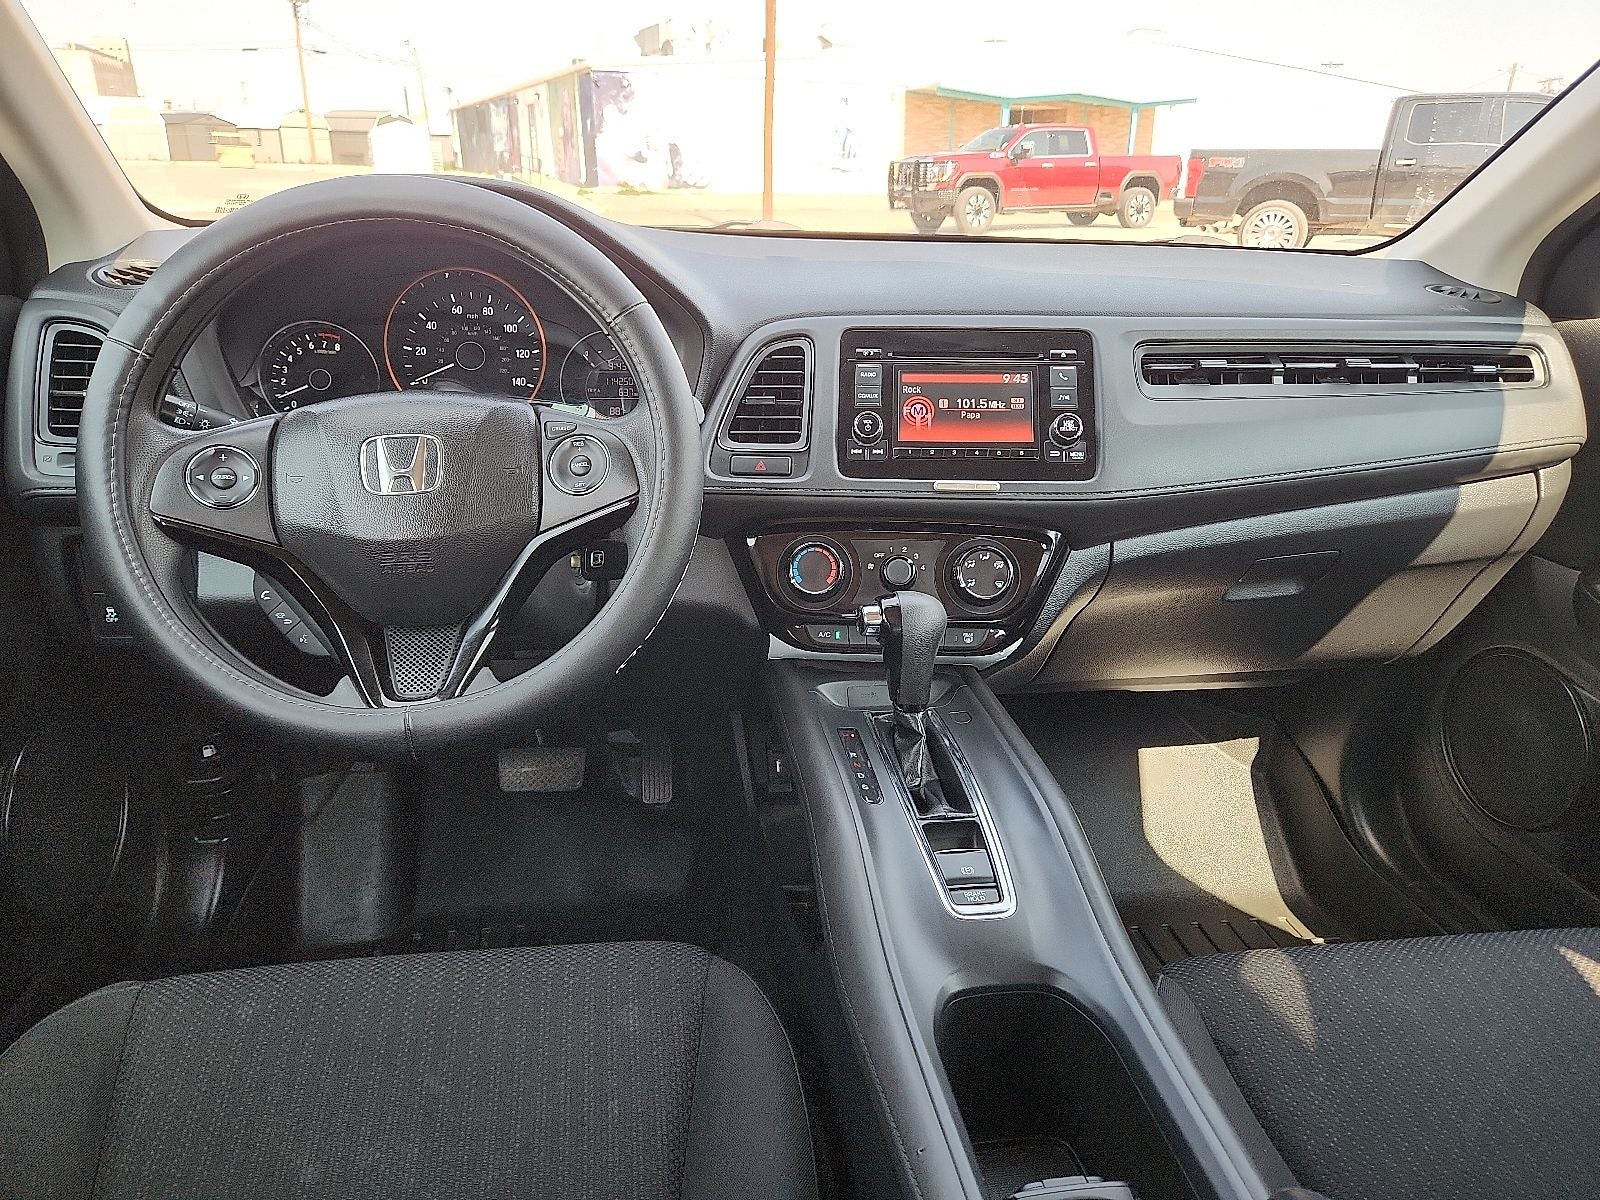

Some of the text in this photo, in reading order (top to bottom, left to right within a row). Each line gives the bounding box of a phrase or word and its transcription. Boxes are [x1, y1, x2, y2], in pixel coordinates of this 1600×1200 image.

[451, 306, 463, 315] 60
[482, 307, 494, 316] 80
[426, 321, 437, 330] 40
[503, 324, 518, 333] 100
[308, 341, 315, 350] 6
[322, 340, 328, 349] 7
[334, 343, 341, 352] 8
[296, 347, 303, 355] 5
[415, 347, 427, 356] 20
[516, 350, 530, 359] 120
[282, 366, 288, 374] 3
[512, 378, 526, 386] 140
[606, 377, 634, 386] 114250
[902, 386, 922, 394] Rock
[961, 411, 981, 420] Papa
